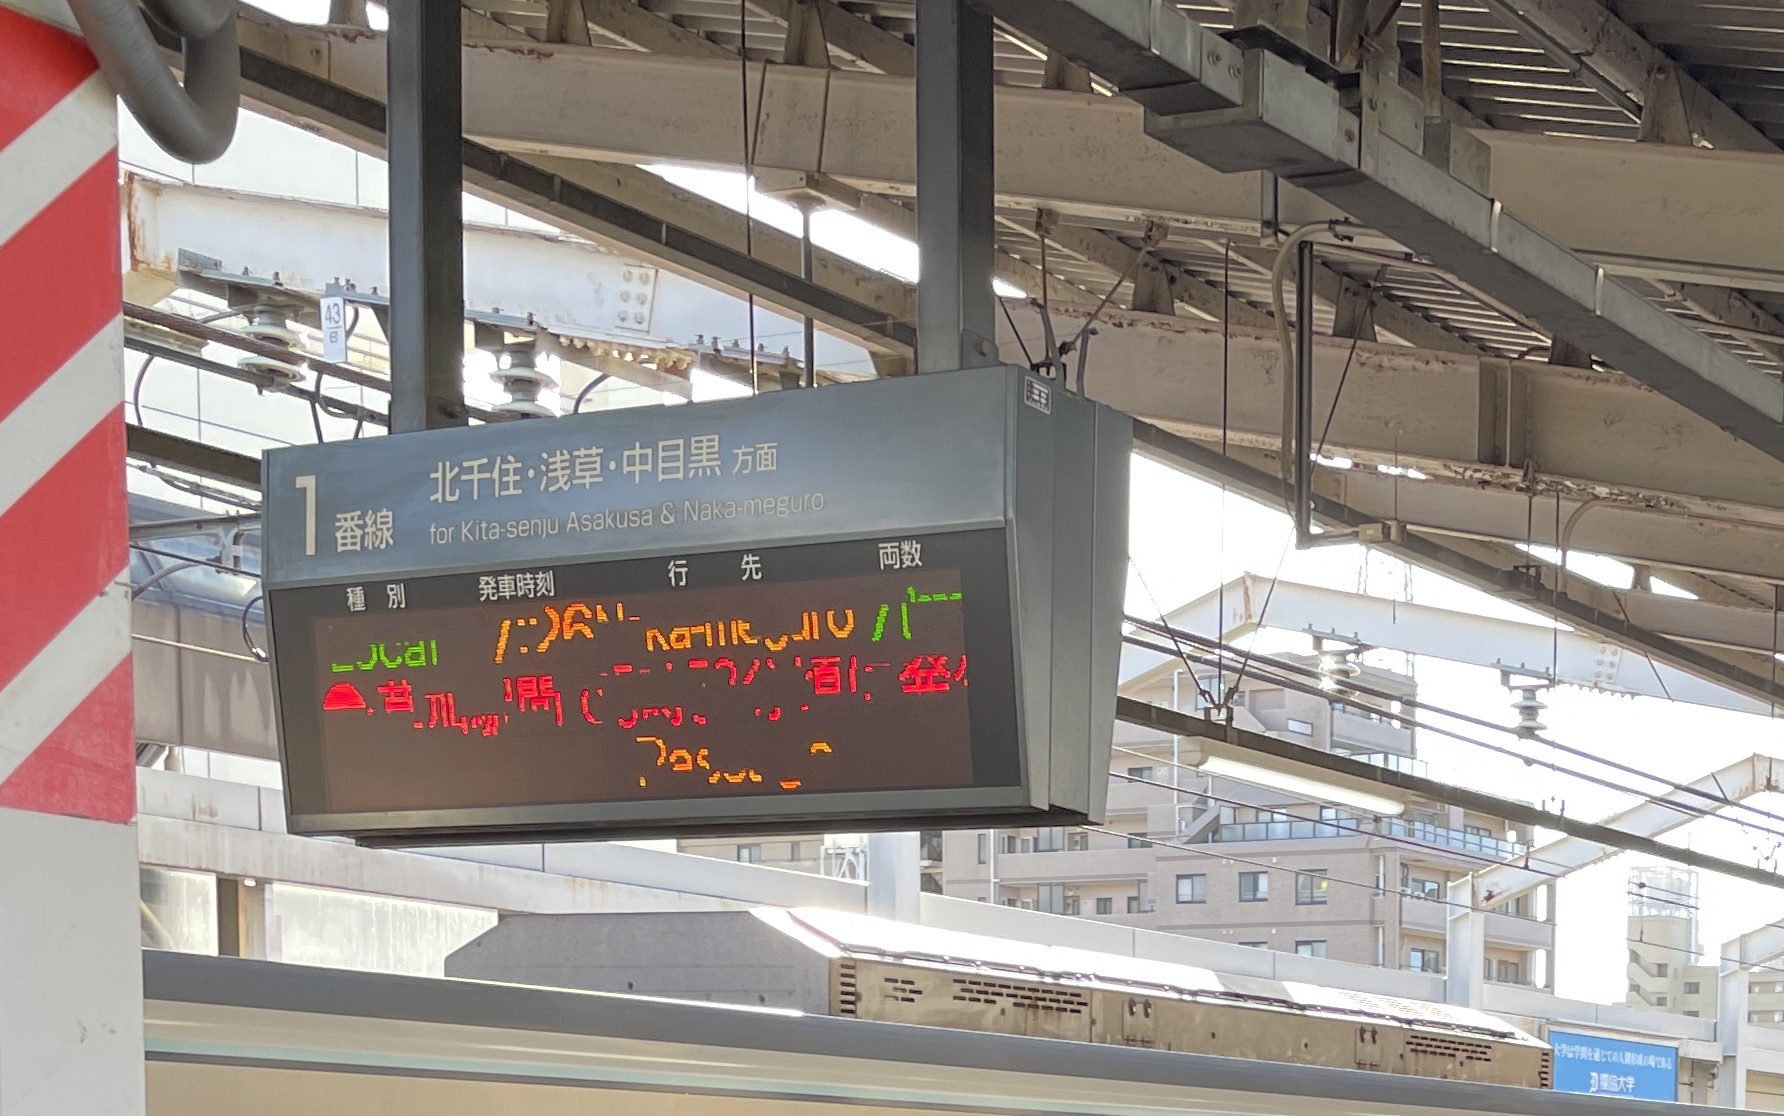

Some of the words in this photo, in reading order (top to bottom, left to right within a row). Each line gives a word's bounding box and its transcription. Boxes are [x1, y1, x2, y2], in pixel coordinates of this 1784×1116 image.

[324, 302, 341, 325] 43
[429, 434, 721, 504] 北千住・浅草・中目黒
[732, 442, 779, 475] 方面
[295, 475, 317, 556] 1
[334, 509, 394, 554] 番線
[430, 521, 455, 545] for
[461, 512, 560, 542] Kita-senju
[566, 506, 653, 533] Asakusa
[660, 504, 676, 524] &
[683, 490, 825, 522] Naka-meguro
[878, 539, 922, 570] 両数
[347, 582, 406, 612] 種別
[479, 570, 556, 602] 発車時刻
